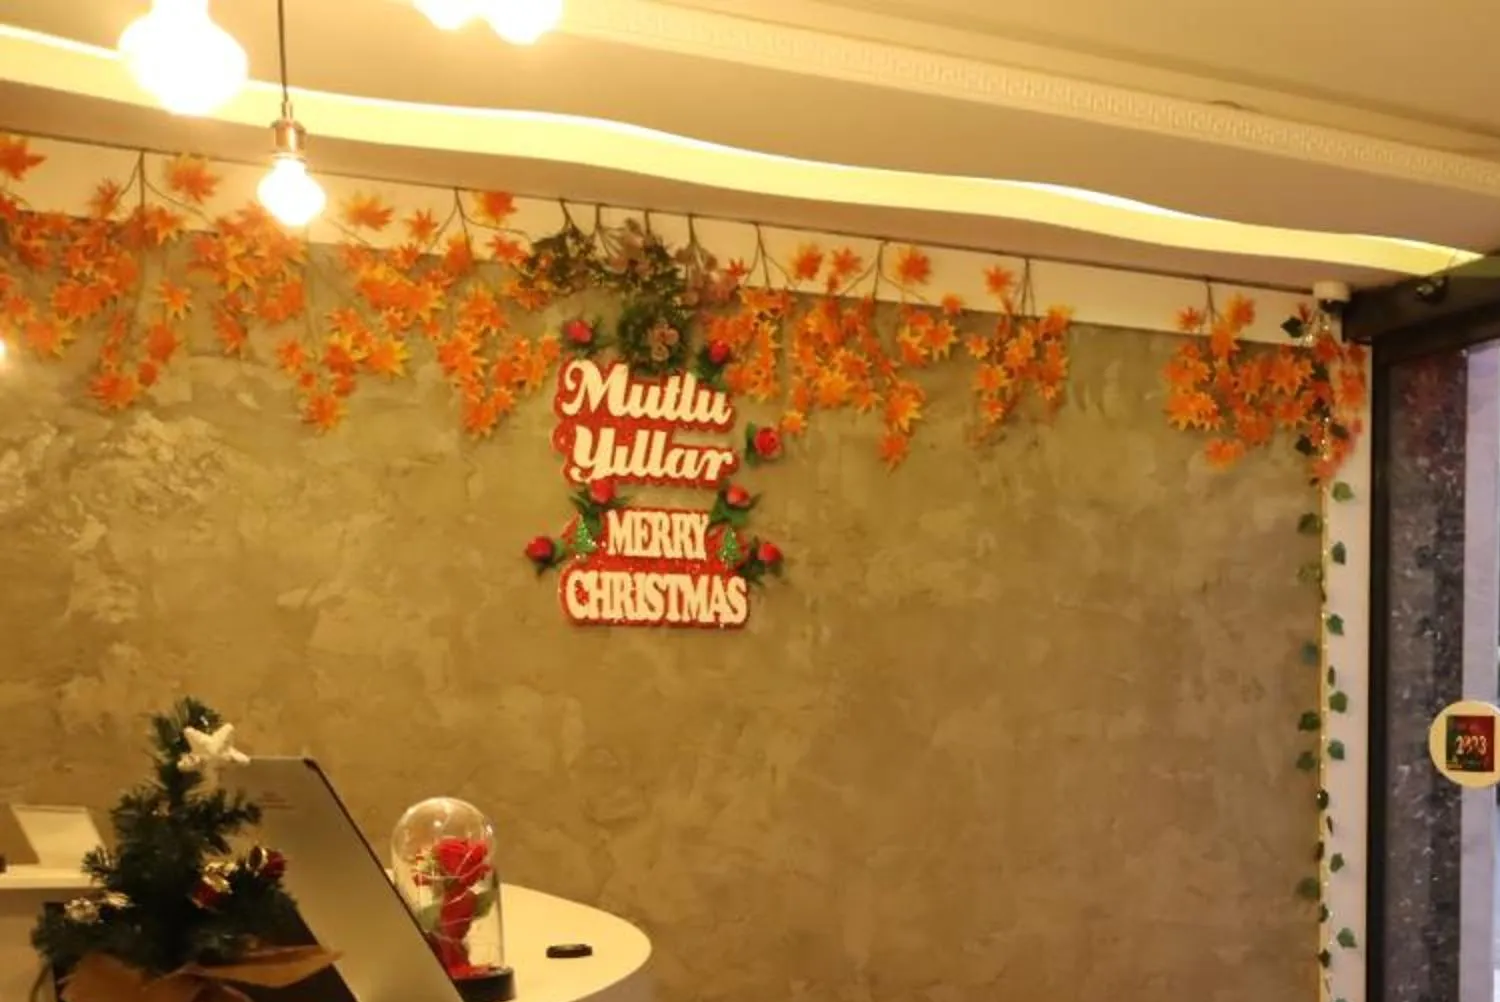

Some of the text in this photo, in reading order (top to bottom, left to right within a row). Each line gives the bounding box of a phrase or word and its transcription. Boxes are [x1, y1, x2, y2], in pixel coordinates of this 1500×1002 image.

[560, 359, 732, 425] Mutlu
[605, 509, 710, 561] MERRY
[565, 569, 748, 624] CHRISTMAS
